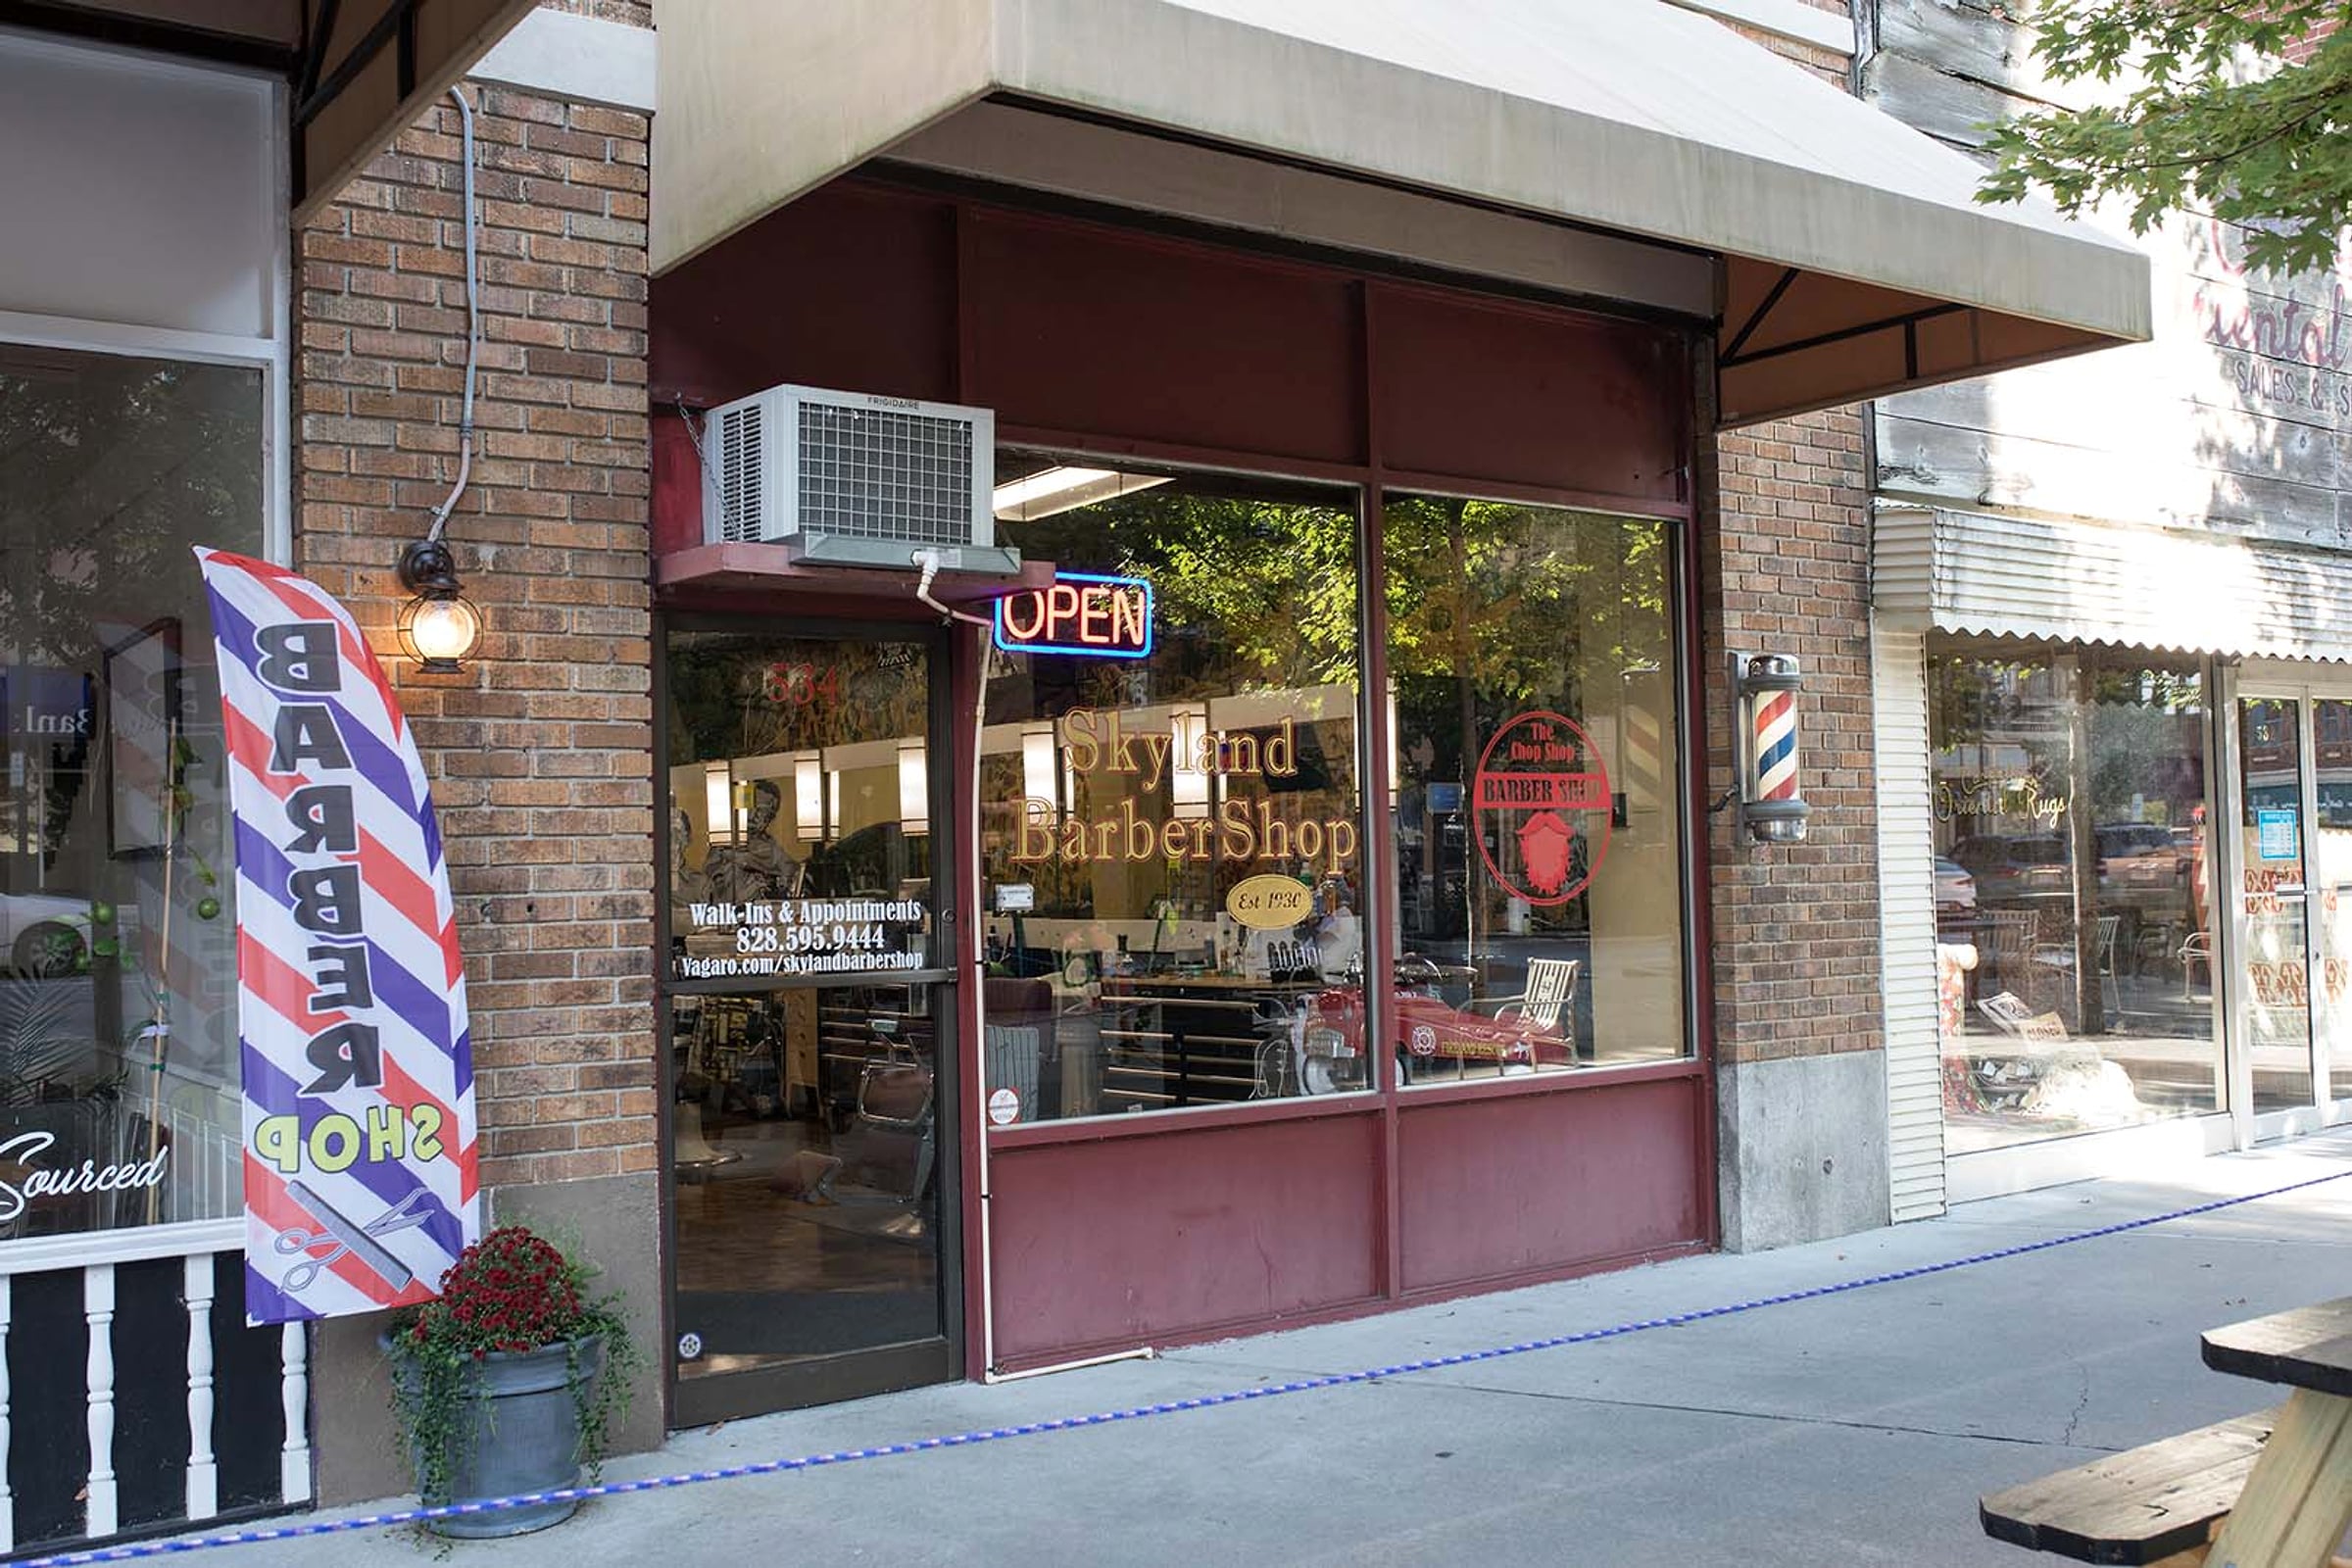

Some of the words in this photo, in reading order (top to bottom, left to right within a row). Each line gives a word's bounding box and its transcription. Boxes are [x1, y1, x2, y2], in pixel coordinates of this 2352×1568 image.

[2235, 360, 2295, 404] SALES
[2310, 377, 2324, 411] &
[2339, 384, 2352, 416] S
[1004, 585, 1145, 645] OPEN
[768, 662, 839, 707] 534
[1062, 706, 1298, 792] Skyland
[1531, 722, 1553, 741] The
[1511, 742, 1542, 761] Chop
[1544, 742, 1576, 761] Shop
[1484, 779, 1552, 803] BARBER
[2018, 784, 2067, 829] Rugs
[1009, 796, 1356, 876] BarberShop
[689, 902, 773, 926] Walk-Ins
[778, 899, 795, 924] &
[800, 899, 922, 925] Appointments
[1239, 892, 1259, 910] Est
[1268, 891, 1301, 909] 1930
[736, 924, 884, 953] 828.595.9444
[683, 950, 923, 977] Vagaro.com/skylandbarbershop
[0, 1131, 169, 1221] Sourced
